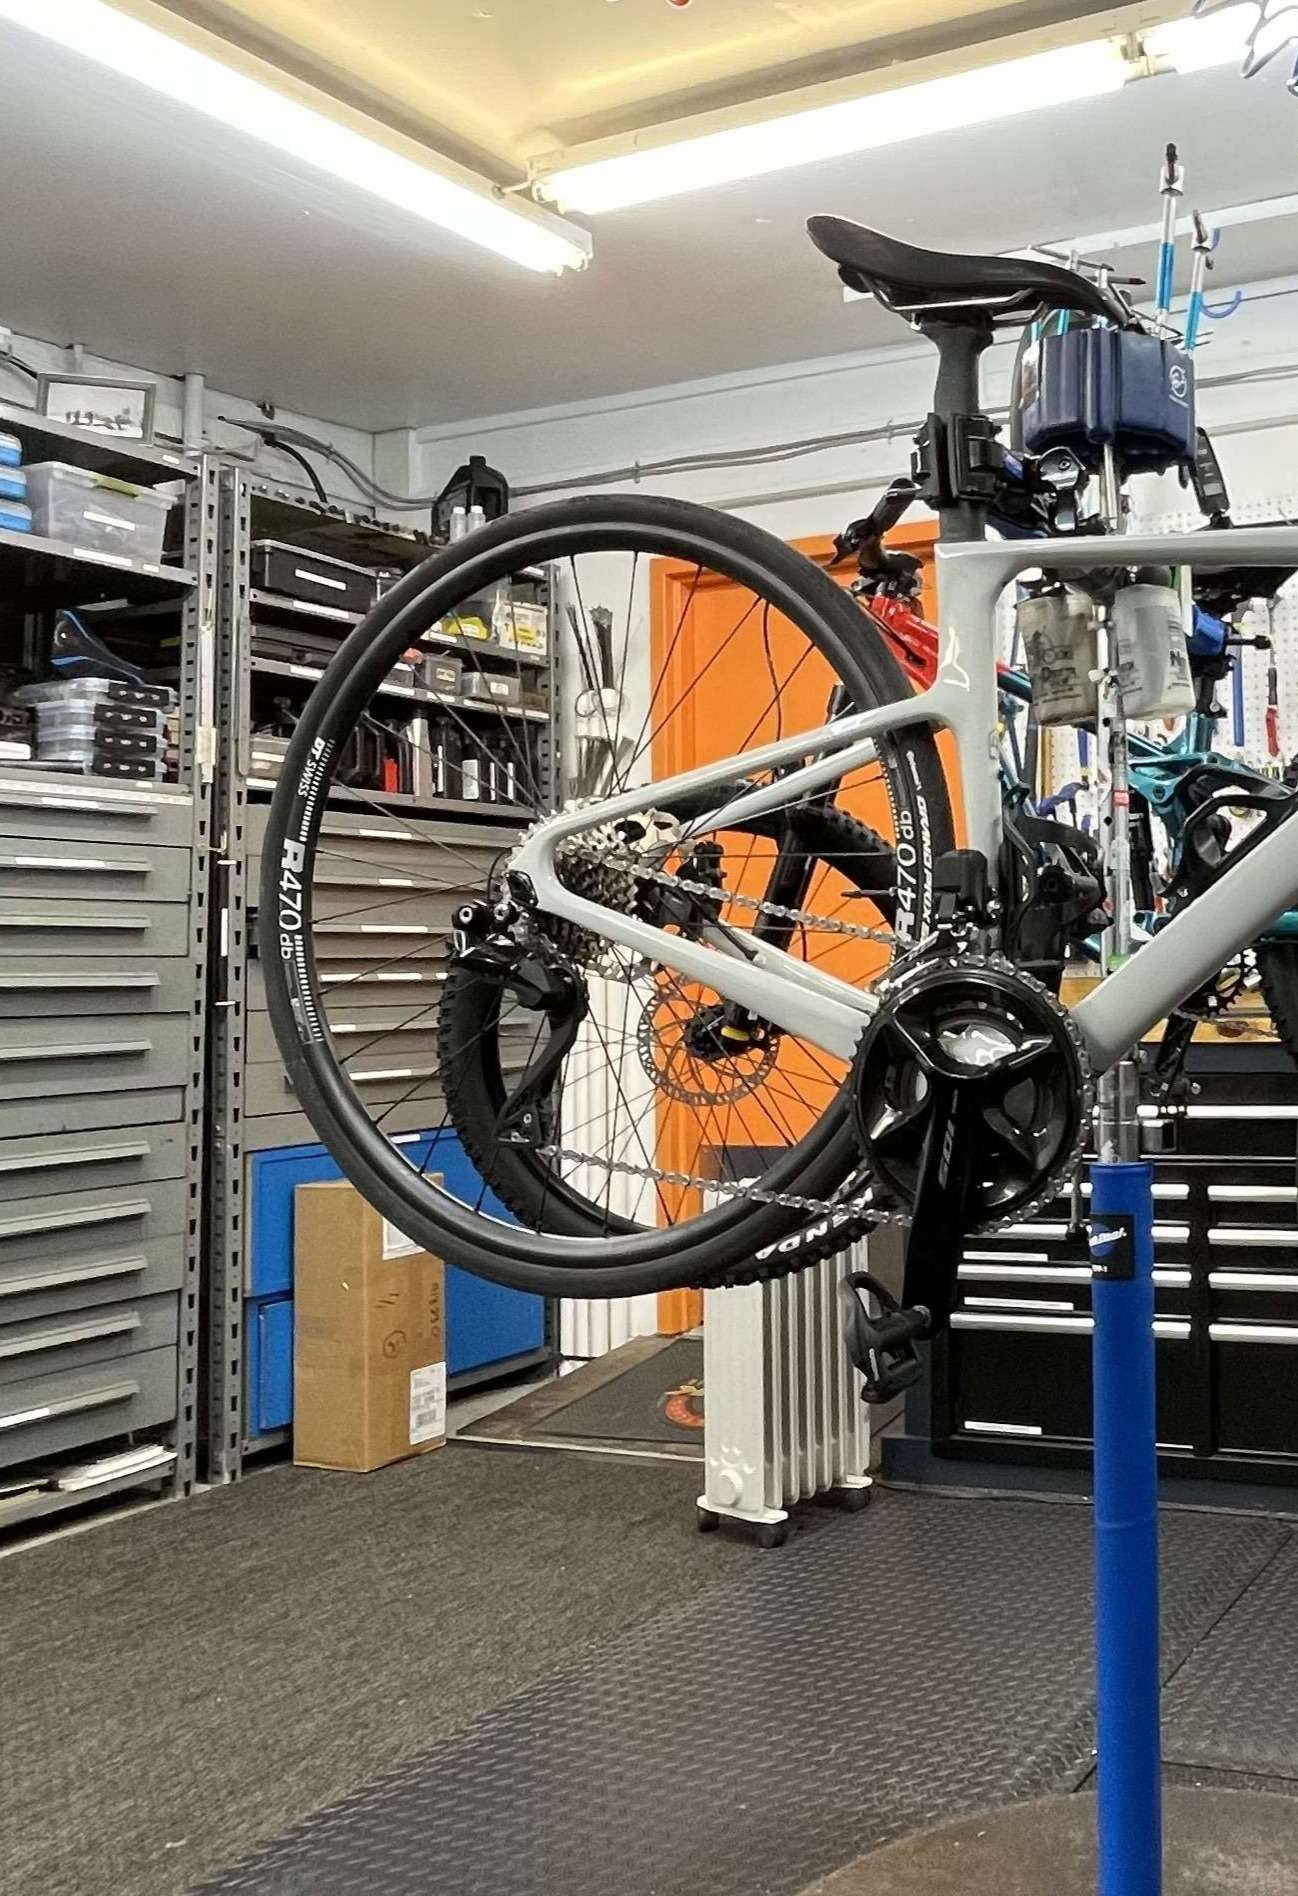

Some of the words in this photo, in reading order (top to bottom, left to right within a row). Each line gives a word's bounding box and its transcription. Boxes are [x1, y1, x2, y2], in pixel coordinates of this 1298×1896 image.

[311, 736, 326, 760] DT
[297, 759, 317, 798] SWISS
[899, 810, 915, 840] db
[279, 837, 306, 932] R470
[895, 842, 918, 948] R470
[280, 934, 294, 960] db
